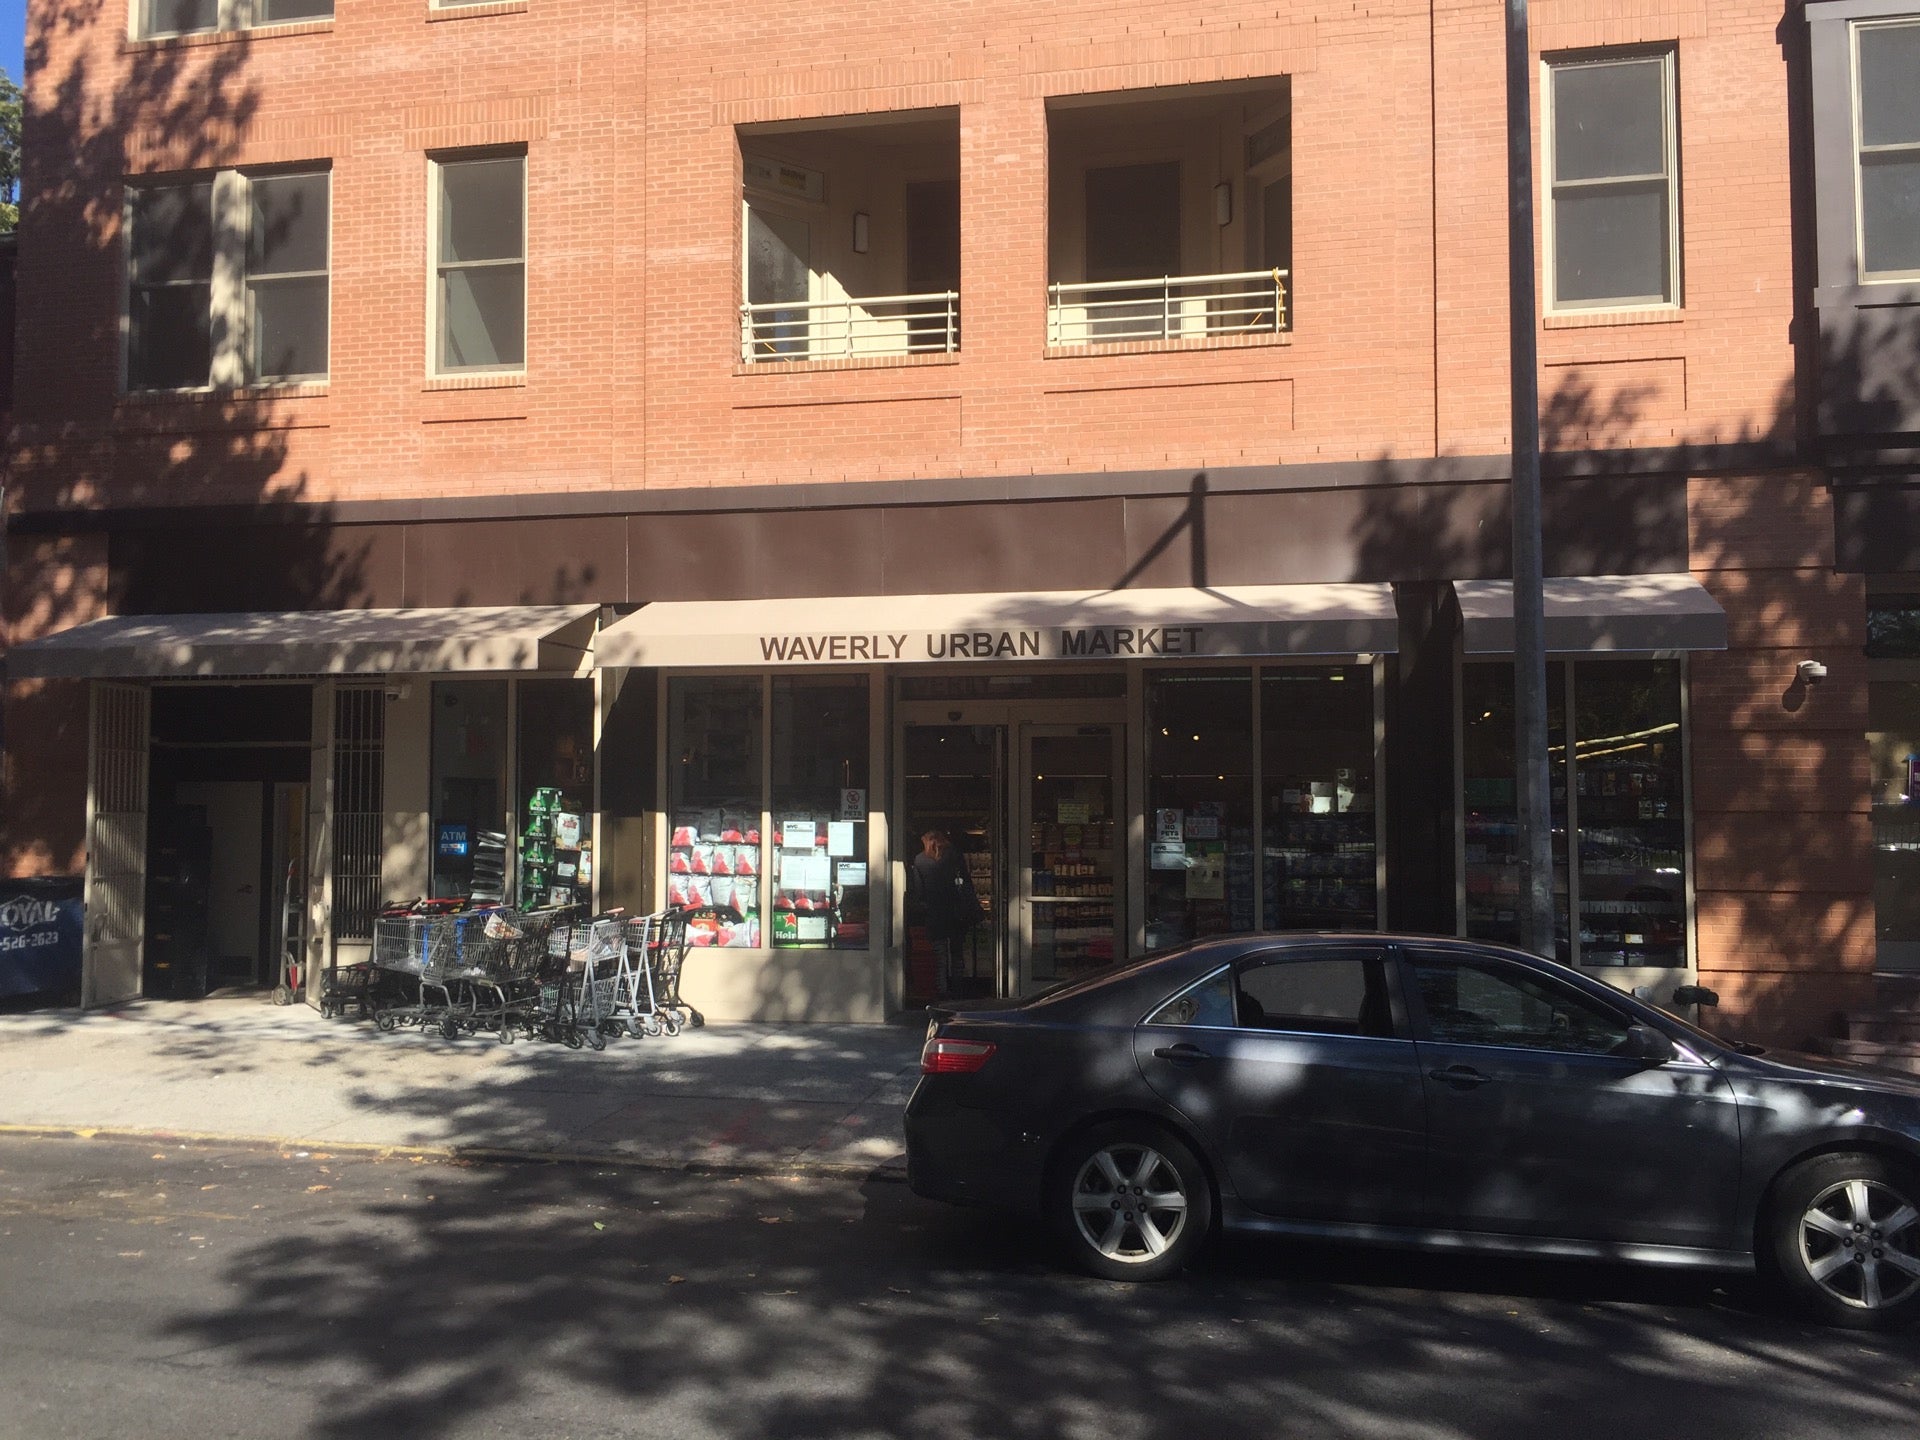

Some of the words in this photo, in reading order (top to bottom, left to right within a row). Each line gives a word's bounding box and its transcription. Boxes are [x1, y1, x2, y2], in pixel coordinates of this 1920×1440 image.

[760, 634, 908, 661] WAVERLY
[927, 631, 1040, 658] URBAN
[1061, 627, 1203, 655] MARKET
[440, 831, 467, 841] ATM
